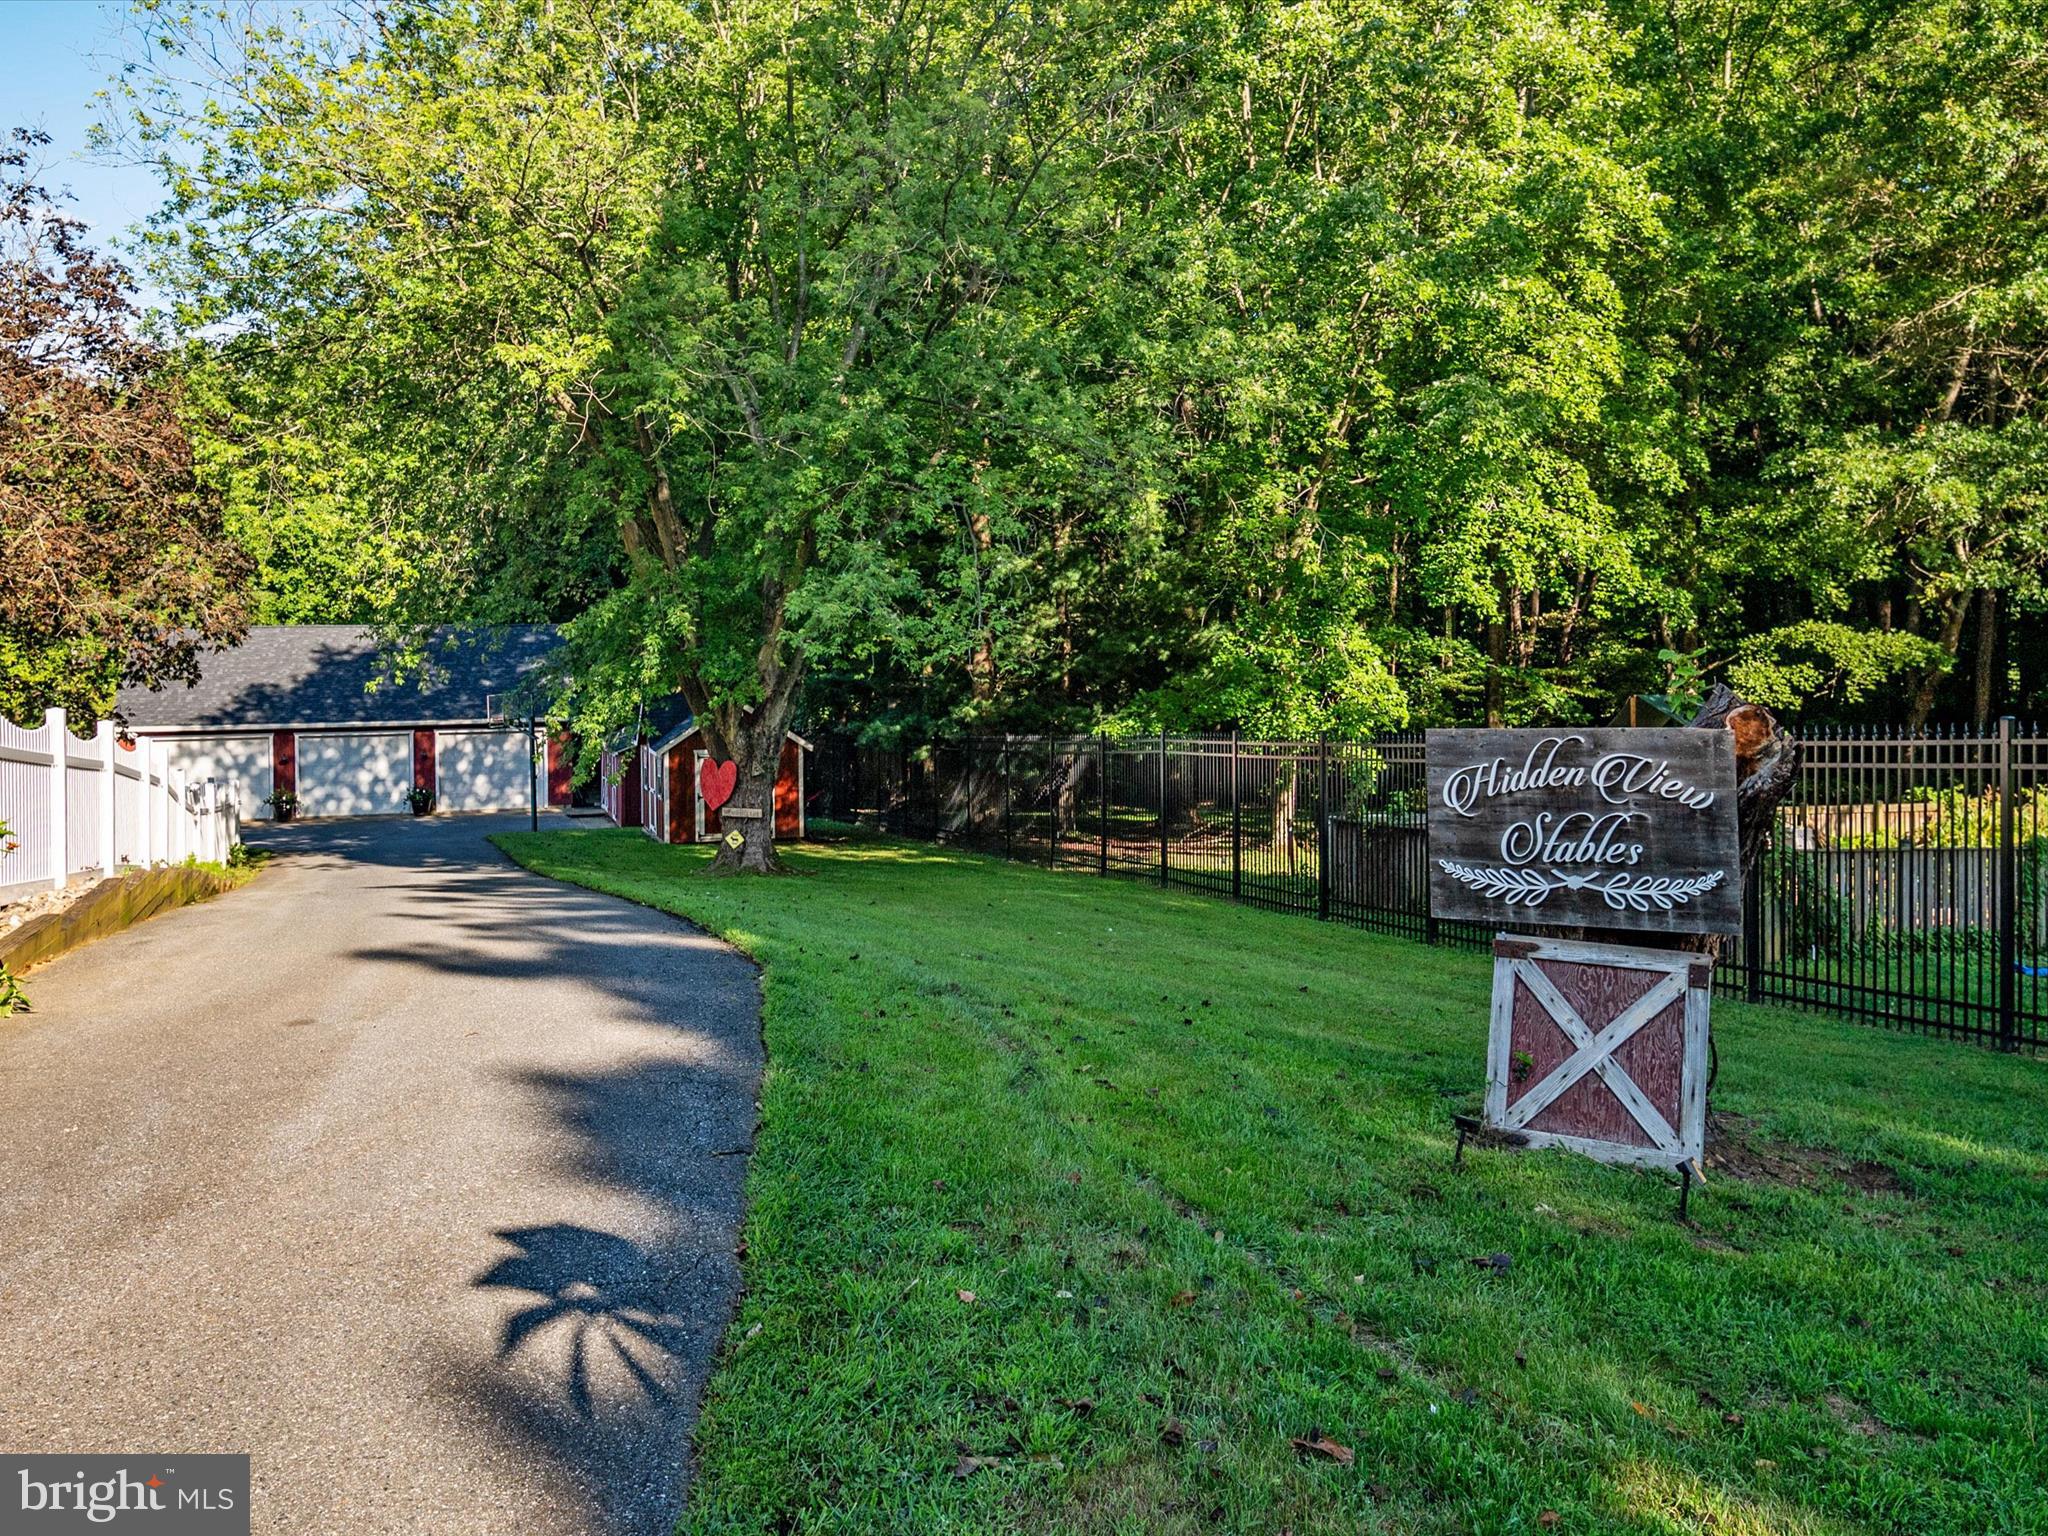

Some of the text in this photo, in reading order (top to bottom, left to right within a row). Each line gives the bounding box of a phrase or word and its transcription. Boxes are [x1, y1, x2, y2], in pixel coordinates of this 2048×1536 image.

[1443, 736, 1714, 817] Hidden View
[1501, 812, 1650, 866] Stables
